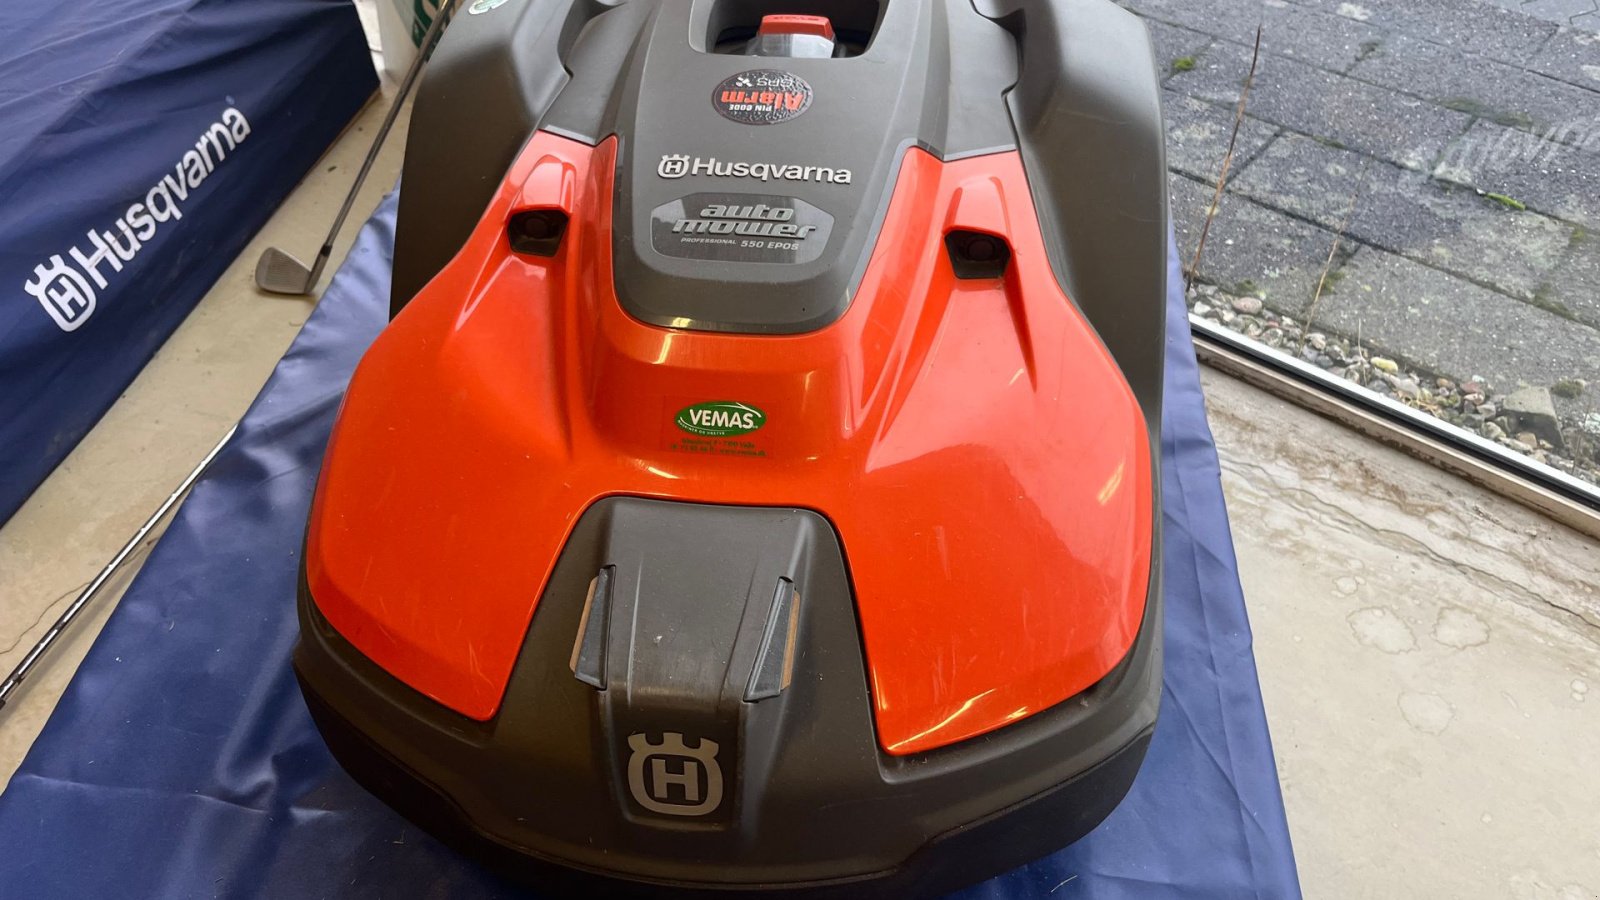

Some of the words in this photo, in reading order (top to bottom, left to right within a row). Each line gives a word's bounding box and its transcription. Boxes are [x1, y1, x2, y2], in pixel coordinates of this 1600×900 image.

[720, 90, 803, 111] Alarm
[691, 157, 852, 184] Husqvarna
[69, 107, 251, 290] Husqvarna
[700, 204, 794, 221] auto
[672, 219, 816, 239] mower
[680, 237, 737, 245] PROFESSIONAL
[740, 240, 764, 249] 550
[767, 241, 799, 251] EPOS
[689, 409, 754, 429] VEMAS
